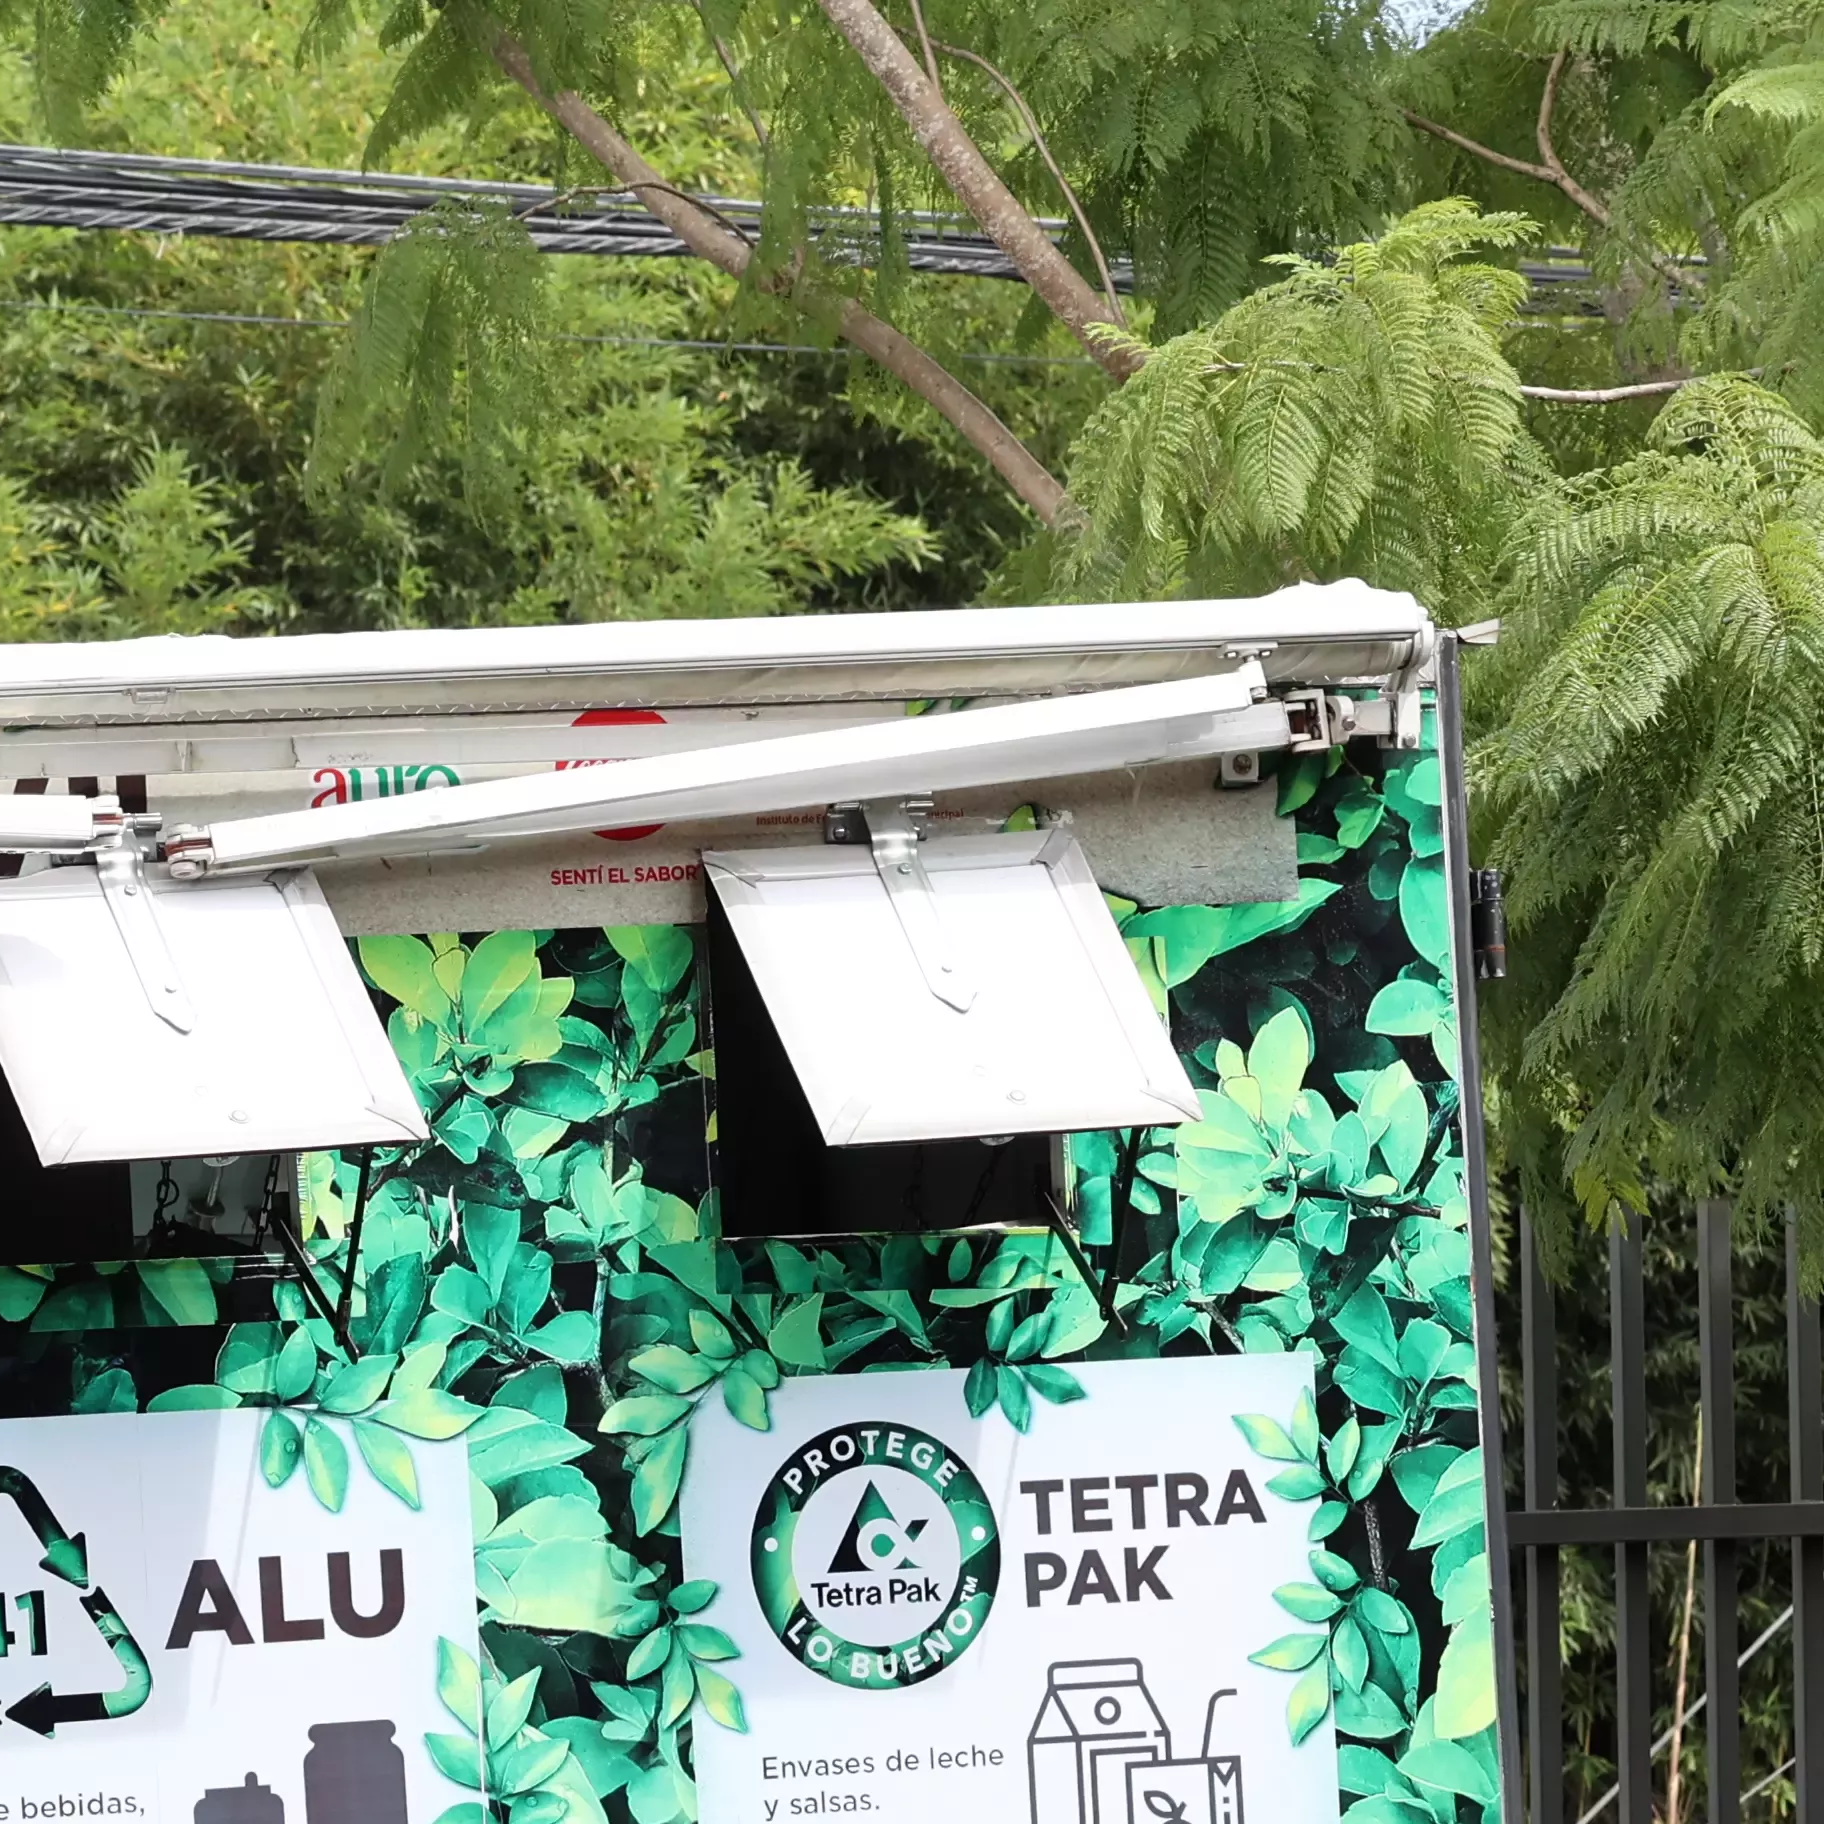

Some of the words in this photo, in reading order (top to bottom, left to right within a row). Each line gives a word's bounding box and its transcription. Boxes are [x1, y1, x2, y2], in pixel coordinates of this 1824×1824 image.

[551, 864, 604, 886] SENTÍ
[608, 868, 630, 884] EL
[635, 865, 698, 883] SABOR
[782, 1428, 961, 1496] PROTEGE
[1019, 1468, 1267, 1536] TETRA
[811, 1579, 883, 1609] Tetra
[888, 1578, 941, 1605] Pak
[1023, 1544, 1174, 1608] PAK
[165, 1548, 406, 1650] ALU
[787, 1615, 833, 1664] LO
[762, 1751, 875, 1781] Envases
[886, 1748, 920, 1773] de
[930, 1744, 1004, 1770] leche
[20, 1791, 146, 1821] bebidas,
[763, 1798, 779, 1821] y
[790, 1788, 880, 1816] salsas.
